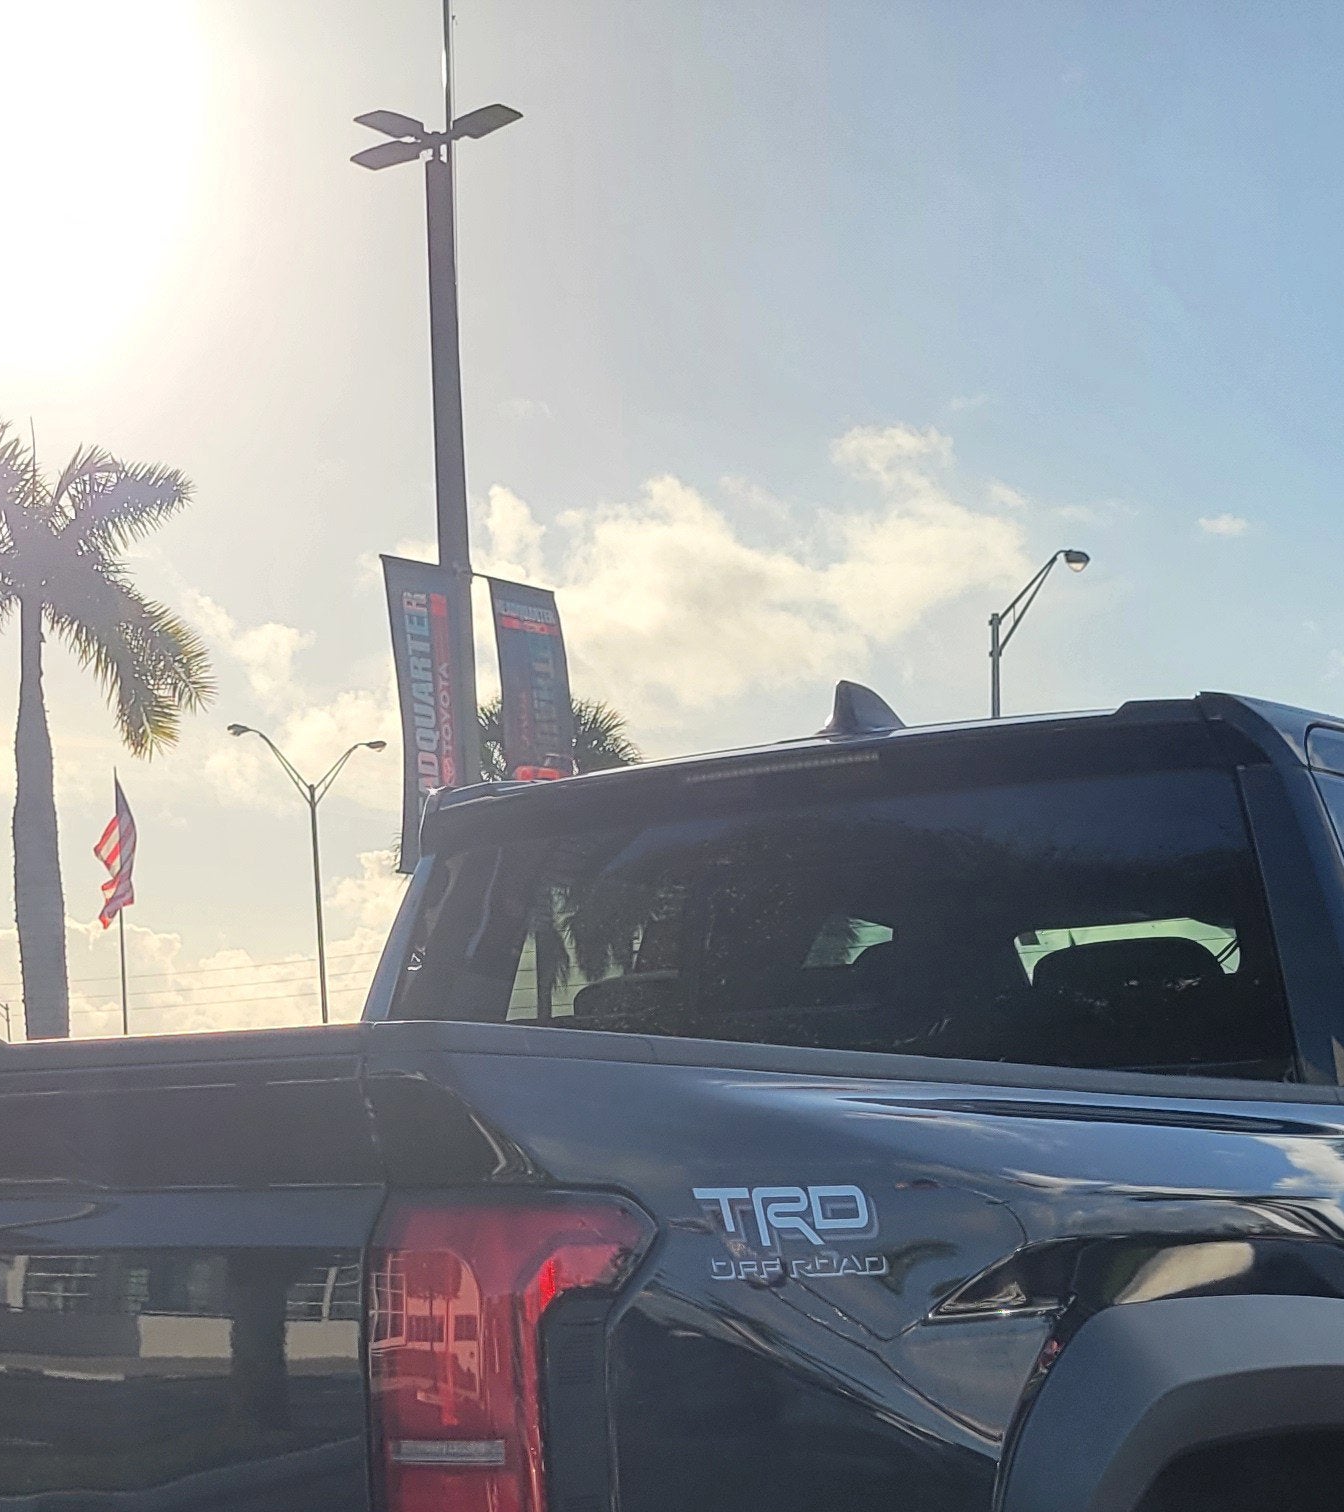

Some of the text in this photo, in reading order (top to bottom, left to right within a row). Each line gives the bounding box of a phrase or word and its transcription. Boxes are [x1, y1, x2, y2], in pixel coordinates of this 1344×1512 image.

[403, 592, 440, 802] ADQUARTER
[438, 661, 453, 754] TOYOTA
[692, 1185, 869, 1247] TRD
[790, 1253, 892, 1279] ROAD
